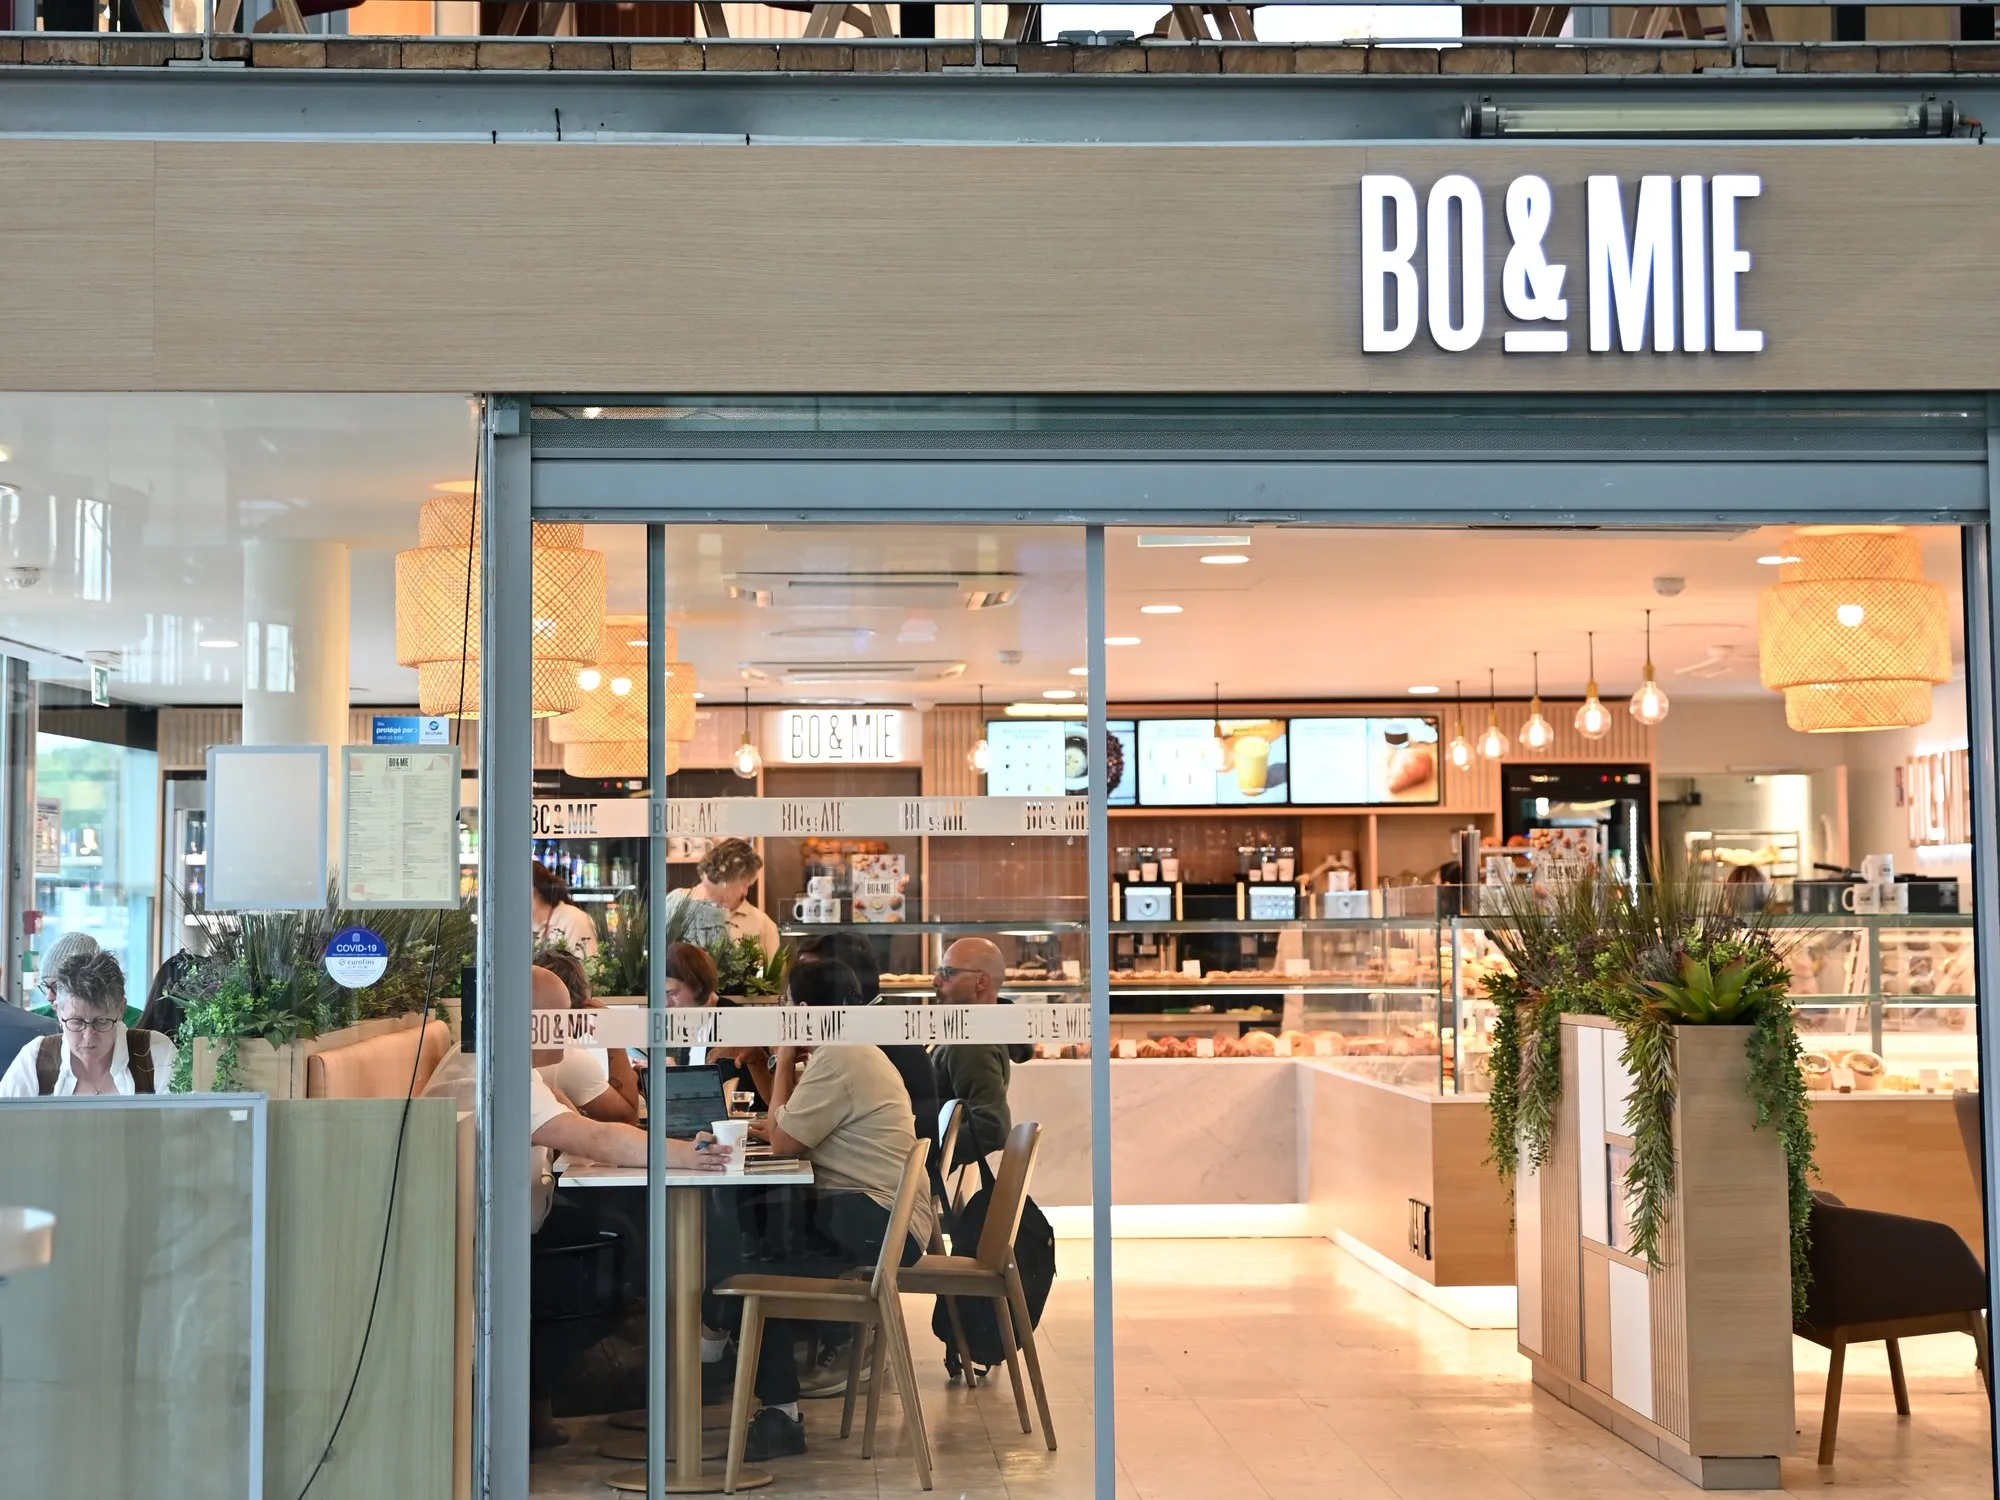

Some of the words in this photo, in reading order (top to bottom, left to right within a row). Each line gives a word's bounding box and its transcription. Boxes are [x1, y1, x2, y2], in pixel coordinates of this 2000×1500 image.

[1361, 174, 1485, 353] BO
[1502, 174, 1568, 353] &
[1586, 174, 1764, 353] MIE
[791, 714, 820, 758] BO
[828, 714, 843, 758] &
[851, 714, 895, 758] MIE
[567, 803, 598, 835] MIE
[336, 944, 377, 953] COVID-19
[532, 1013, 550, 1045] BO
[567, 1013, 598, 1045] MIE
